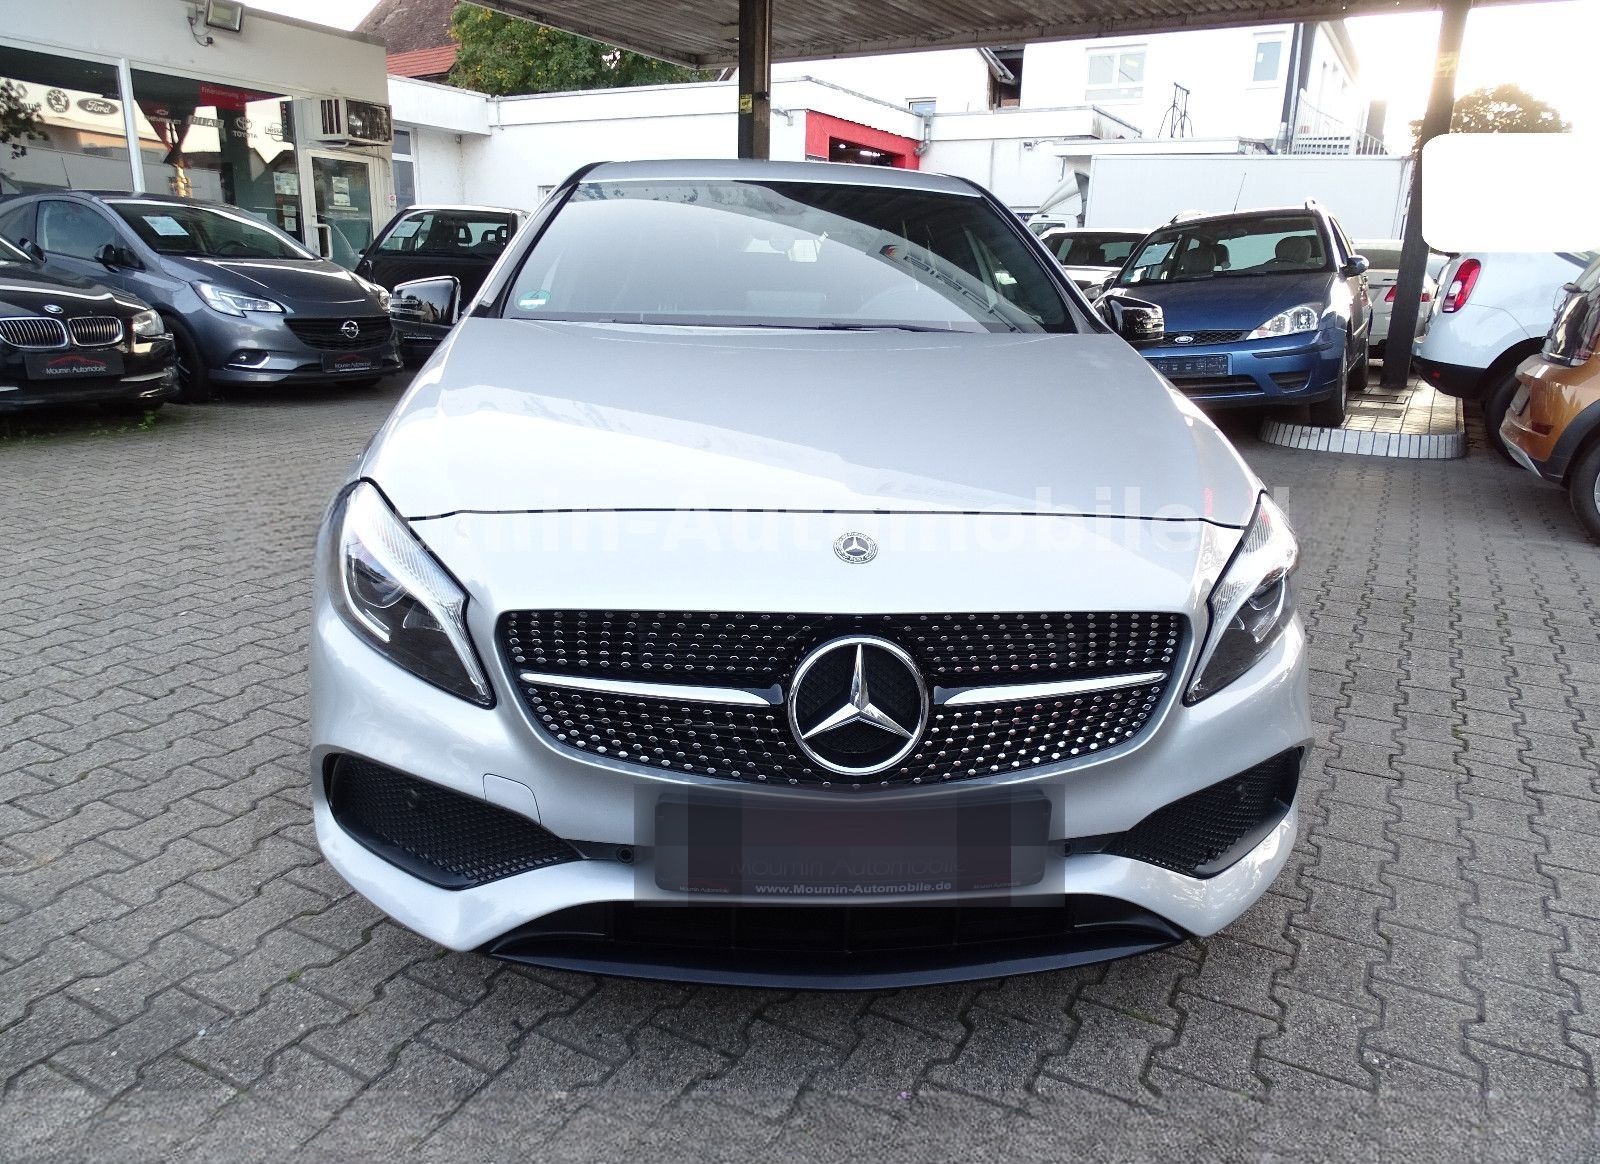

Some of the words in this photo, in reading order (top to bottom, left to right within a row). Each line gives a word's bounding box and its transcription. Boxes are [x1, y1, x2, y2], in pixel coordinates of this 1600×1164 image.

[86, 101, 111, 114] Ford
[232, 130, 258, 139] TOYOTA
[46, 367, 70, 375] Moumin
[730, 856, 823, 876] Moumin
[830, 856, 968, 877] Automobile
[755, 881, 952, 895] www.Moumin-Automobile.de
